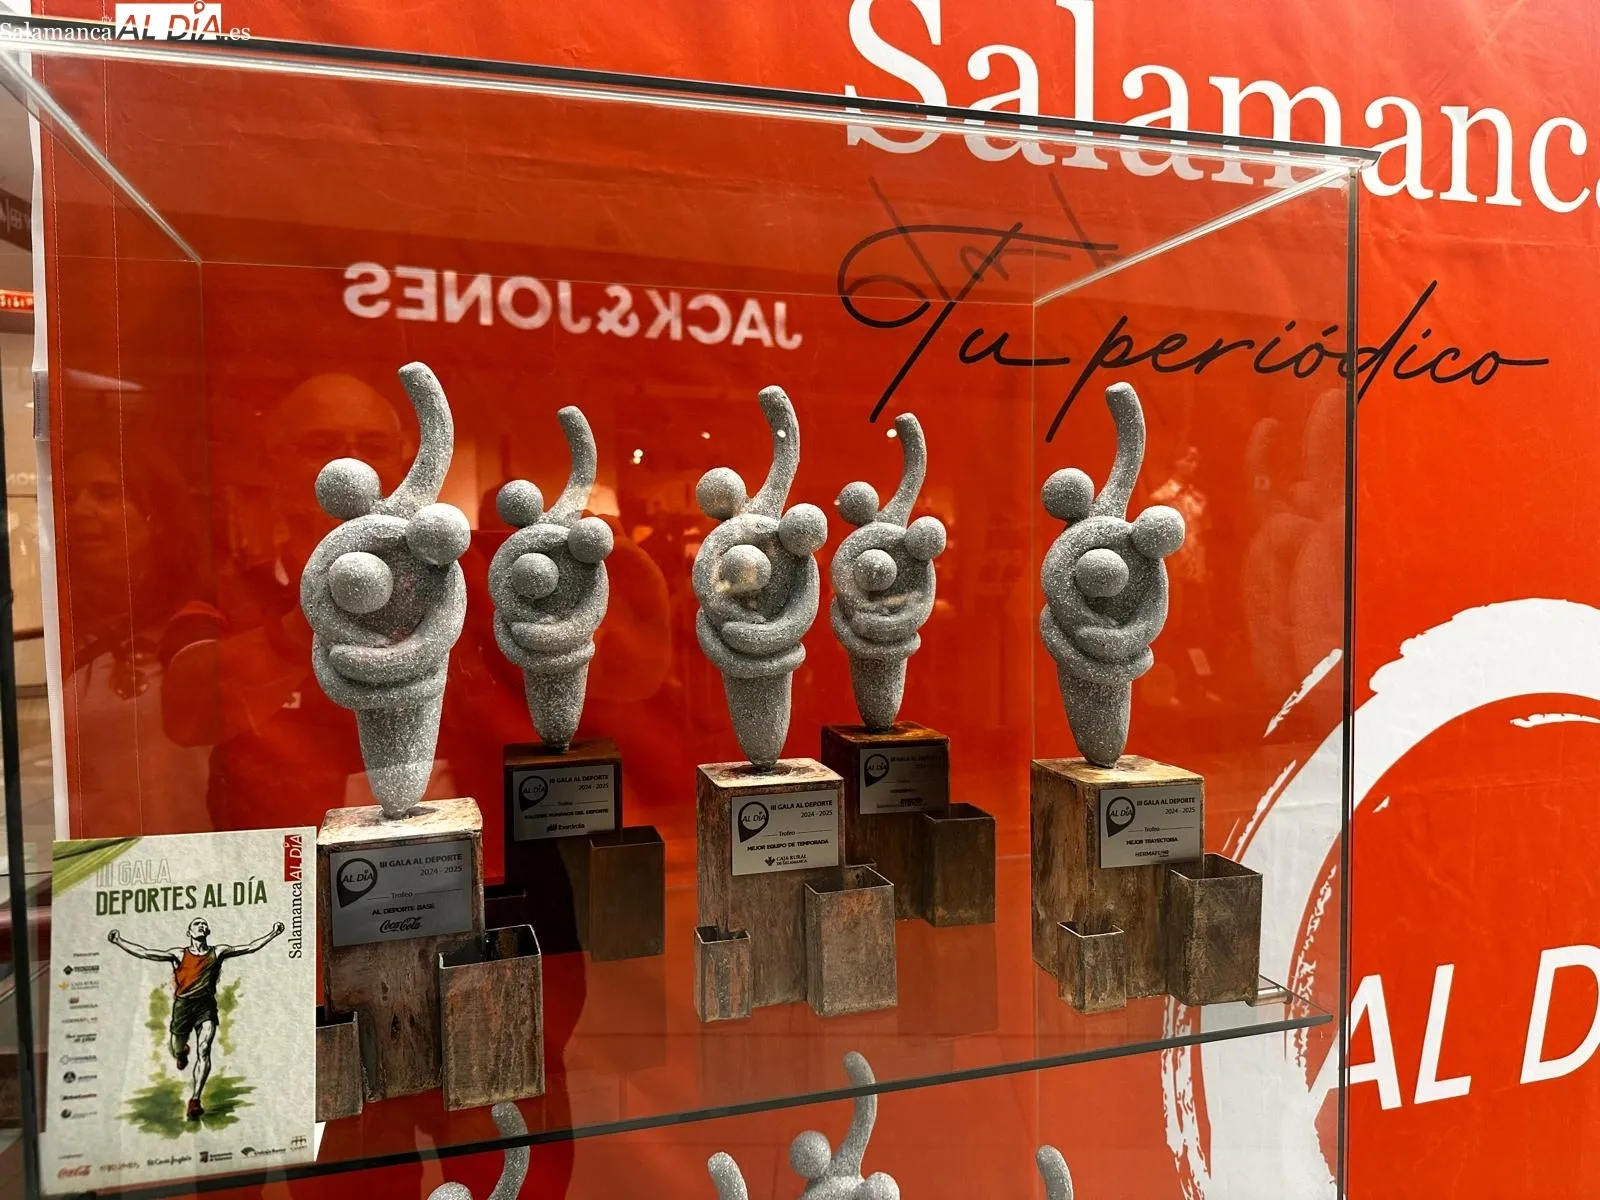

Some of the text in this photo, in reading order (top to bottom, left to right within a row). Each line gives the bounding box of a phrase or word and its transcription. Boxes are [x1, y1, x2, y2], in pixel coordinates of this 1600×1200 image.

[844, 0, 1600, 214] Salamanc
[838, 222, 1549, 443] Tu periódico
[582, 774, 608, 782] DEPORTE
[805, 800, 833, 808] DEPORTE
[1169, 797, 1195, 805] DEPORTE
[797, 839, 829, 847] TEMPORADA
[389, 859, 411, 868] GALA
[412, 858, 423, 866] AL
[425, 853, 463, 864] DEPORTE
[118, 858, 172, 886] GALA
[289, 862, 303, 880] AL
[420, 867, 438, 876] 2024
[444, 865, 463, 874] 2025
[343, 874, 354, 883] AL
[96, 875, 268, 916] DEPORTES AL DÍA
[391, 891, 413, 899] Trofeo
[383, 905, 415, 915] DEPORTE
[417, 903, 435, 911] BASE
[288, 881, 303, 959] Salamanca
[1309, 964, 1471, 1110] AL
